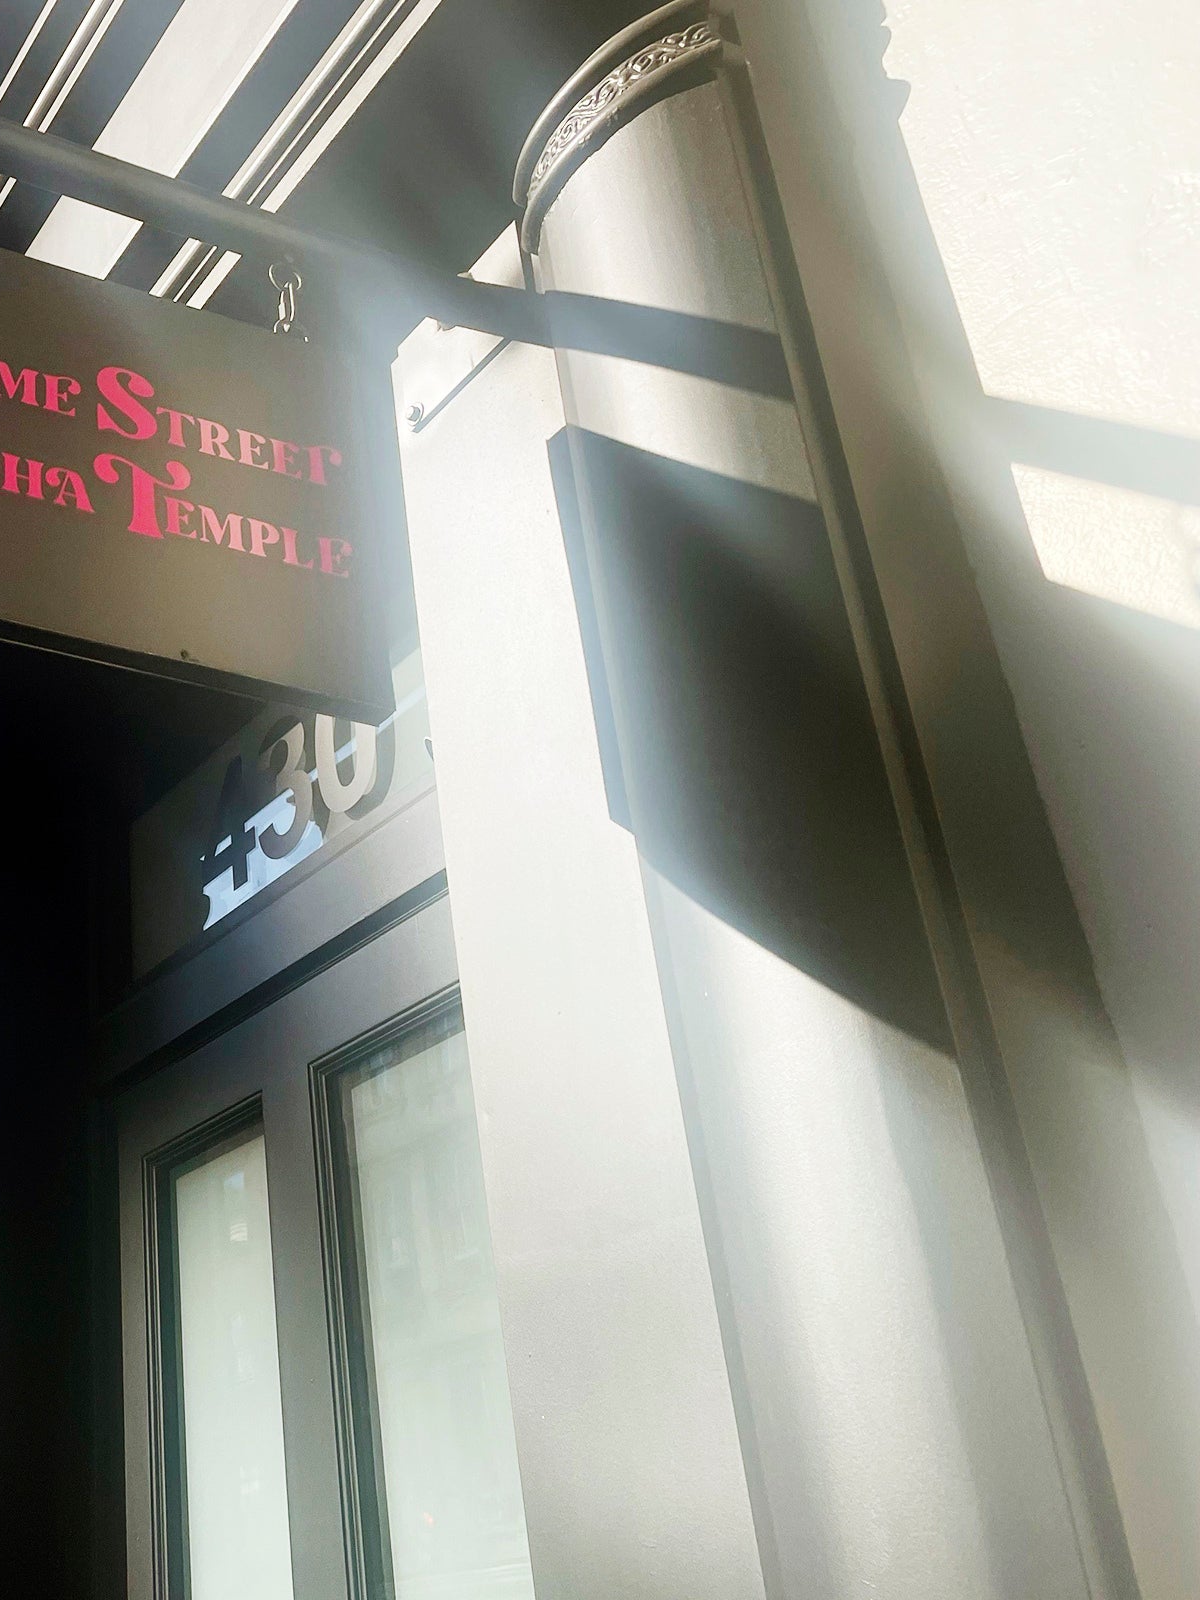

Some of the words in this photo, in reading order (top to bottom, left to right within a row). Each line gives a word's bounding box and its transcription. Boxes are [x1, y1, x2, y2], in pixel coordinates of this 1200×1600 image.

[96, 366, 343, 486] STREET
[93, 452, 353, 578] TEMPLE
[200, 713, 377, 893] 430
